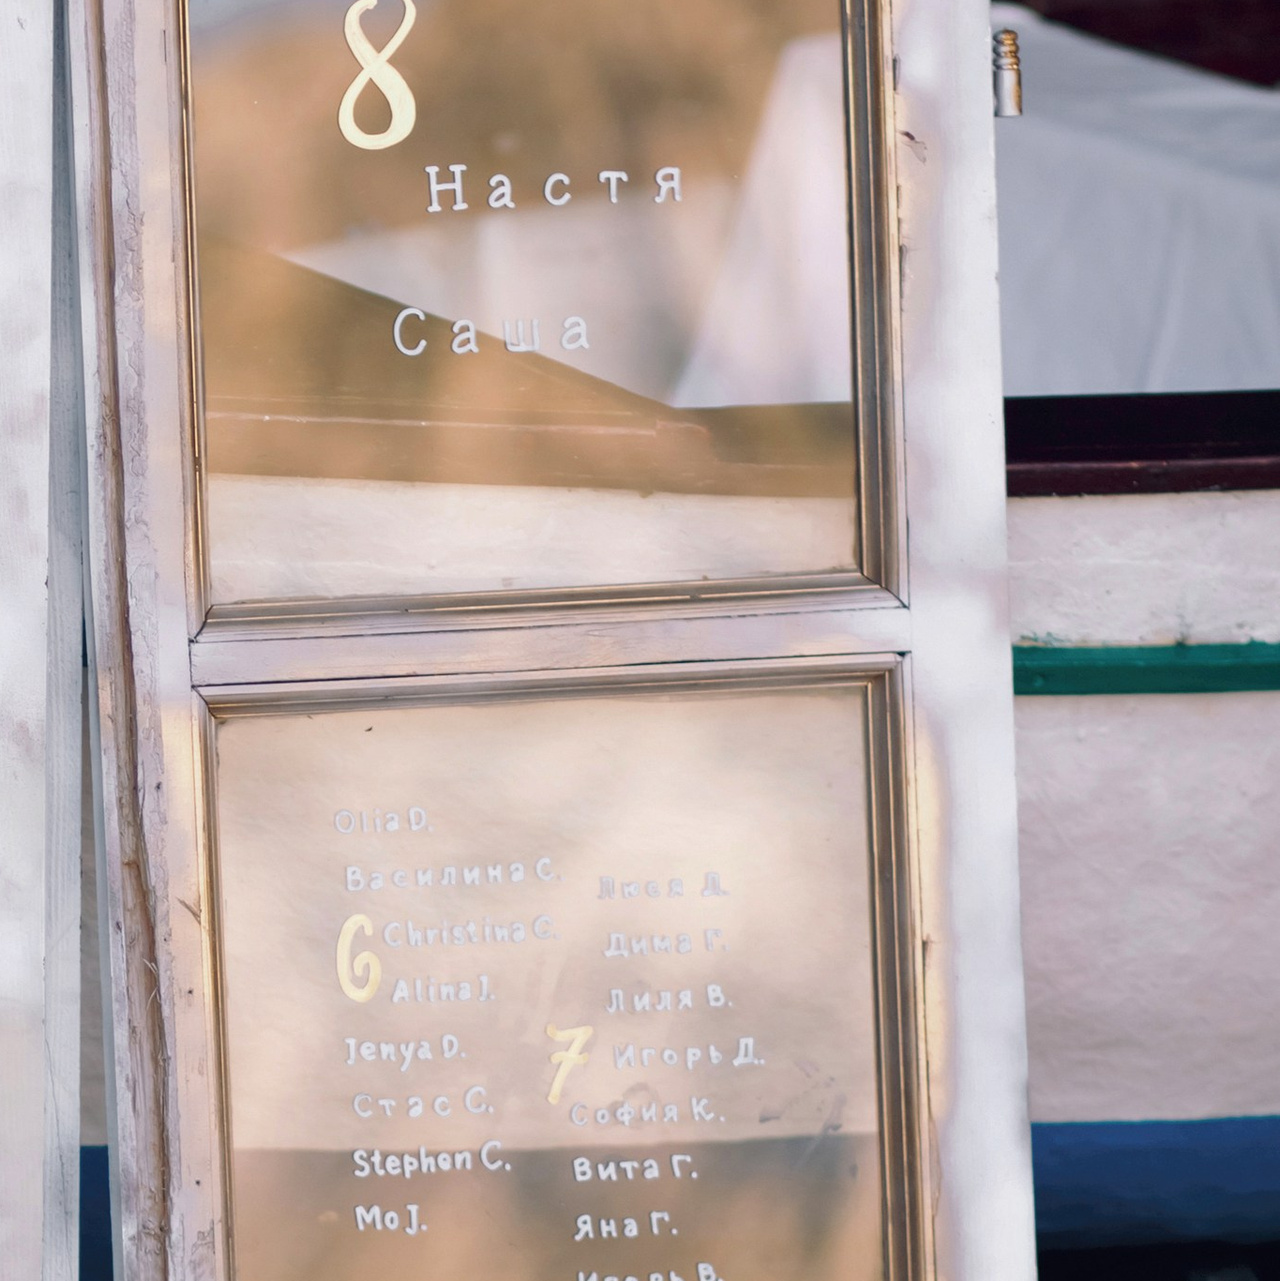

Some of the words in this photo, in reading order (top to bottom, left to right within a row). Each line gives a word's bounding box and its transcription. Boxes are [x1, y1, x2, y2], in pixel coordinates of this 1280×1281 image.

[424, 164, 682, 212] Настя
[393, 307, 590, 356] Саша
[335, 808, 400, 834] Olia
[409, 807, 434, 832] D.
[345, 862, 524, 892] Василина
[536, 858, 565, 882] С.
[598, 876, 684, 901] Люся
[383, 919, 526, 948] Christina
[532, 916, 561, 940] C.
[605, 932, 692, 958] Дима
[704, 930, 730, 953] Г.
[336, 914, 381, 1002] 6
[391, 977, 471, 1004] Alina
[477, 976, 496, 1001] J.
[607, 988, 693, 1014] Лиля
[708, 984, 733, 1008] В.
[344, 1038, 433, 1072] Jenya
[442, 1035, 466, 1059] D.
[546, 1024, 593, 1105] 7
[615, 1041, 723, 1069] Игорь
[353, 1093, 452, 1118] Стас
[465, 1087, 494, 1115] С.
[571, 1102, 678, 1127] София
[691, 1098, 726, 1121] К.
[480, 1141, 512, 1172] C.
[573, 1156, 660, 1183] Вита
[672, 1154, 698, 1180] Г.
[355, 1205, 399, 1231] Mo
[404, 1204, 428, 1235] J.
[574, 1214, 639, 1242] Яна
[649, 1211, 678, 1236] Г.
